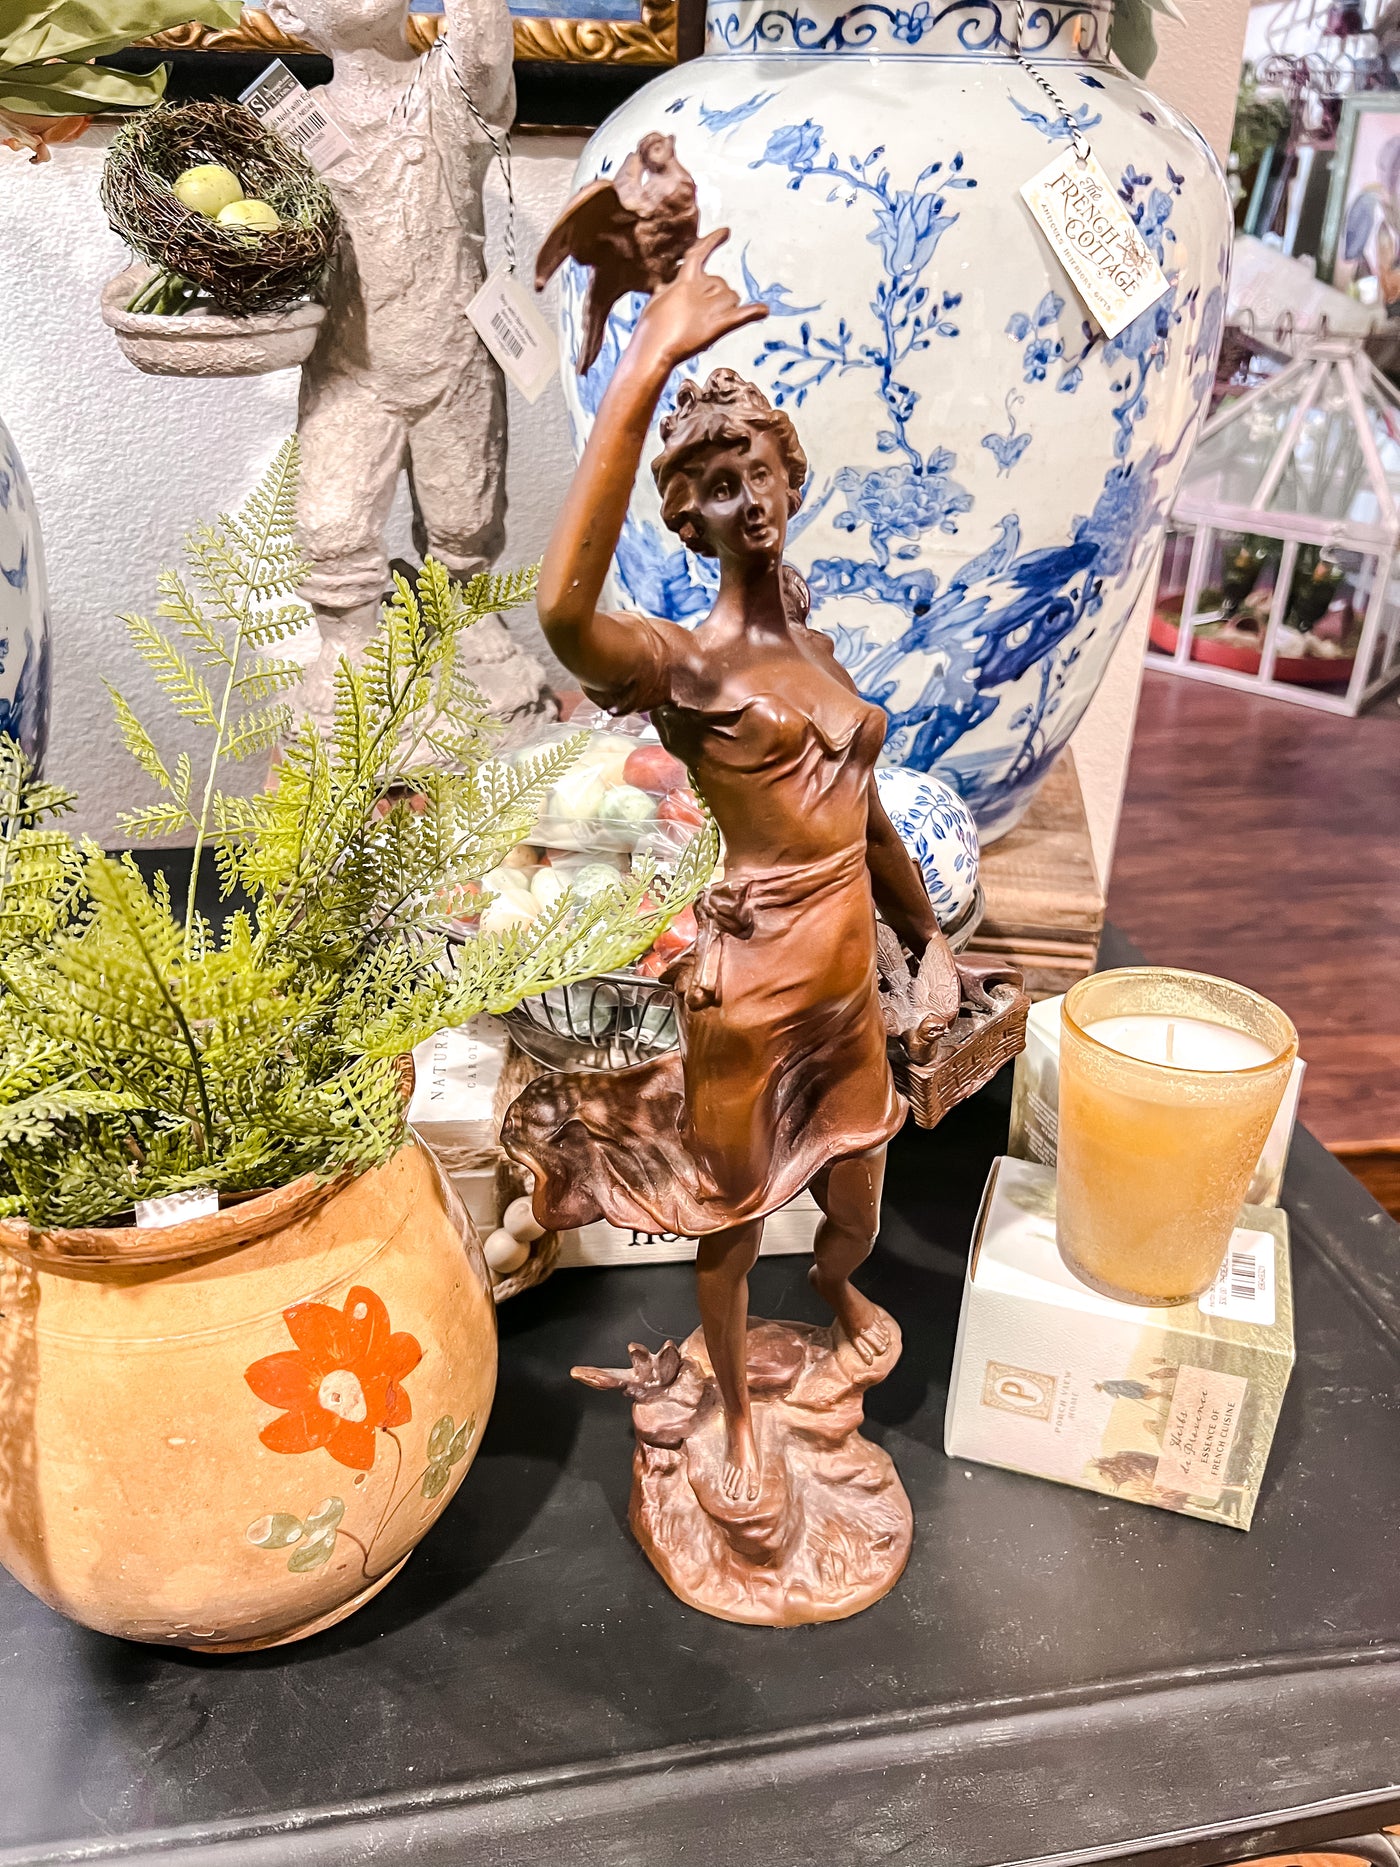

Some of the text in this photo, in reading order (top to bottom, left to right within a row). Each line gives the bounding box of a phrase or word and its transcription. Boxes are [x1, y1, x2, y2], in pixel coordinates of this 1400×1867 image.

[250, 97, 267, 117] S
[1044, 172, 1121, 245] FRENCH
[1079, 176, 1103, 202] The
[1041, 203, 1112, 311] ANTIQUES INTERIORS GIFTS
[1065, 216, 1140, 297] COTTAGE
[431, 1029, 449, 1101] NATURA
[1000, 1381, 1037, 1403] P
[1054, 1370, 1072, 1434] PORCH VIEW
[1067, 1391, 1079, 1420] HOME
[1169, 1410, 1188, 1451] Herbs
[1180, 1389, 1208, 1474] de Provence
[1200, 1408, 1220, 1464] ESSENCE OF
[1210, 1401, 1236, 1476] FRENCH CUISINE
